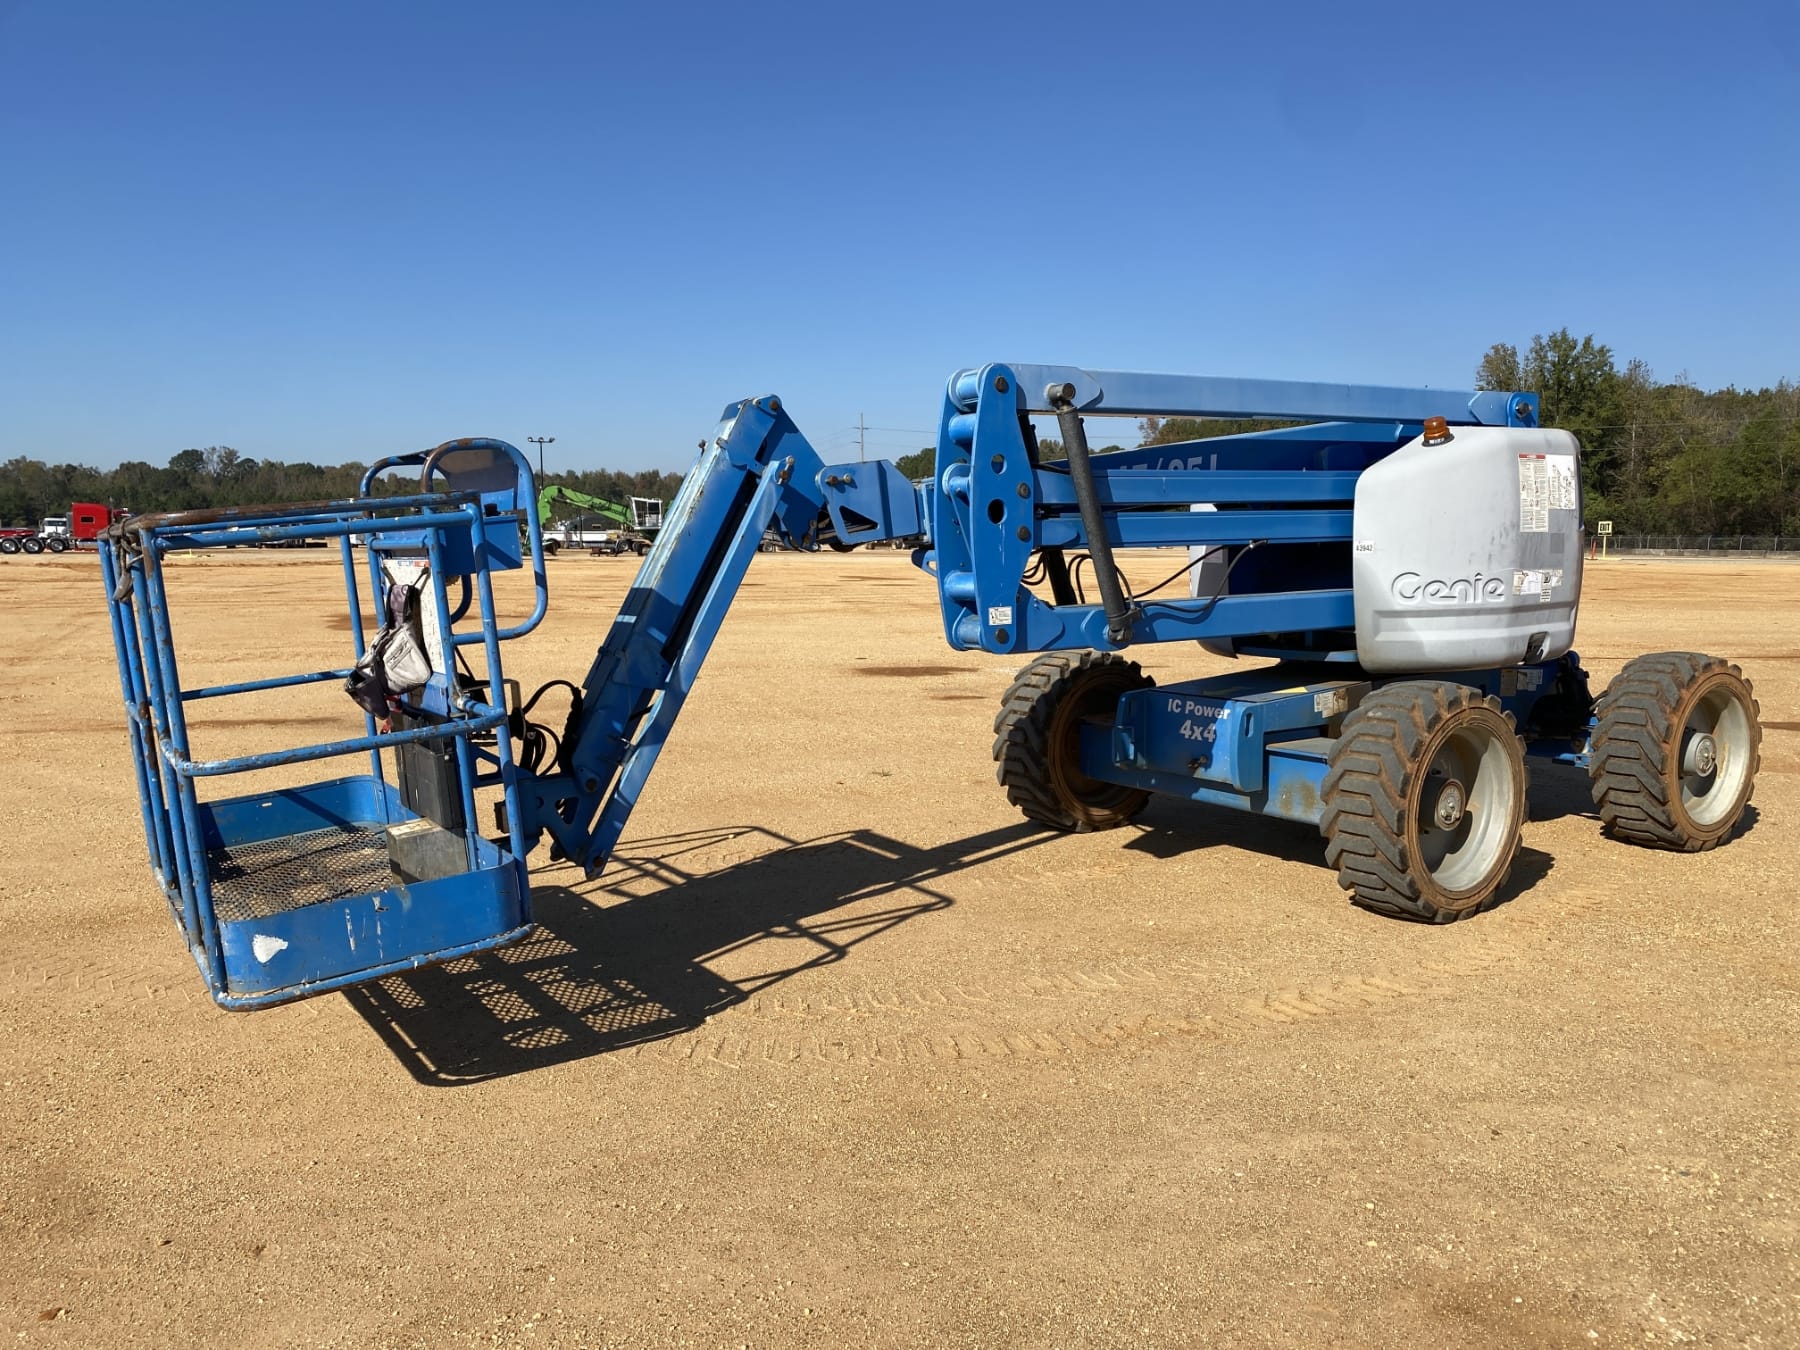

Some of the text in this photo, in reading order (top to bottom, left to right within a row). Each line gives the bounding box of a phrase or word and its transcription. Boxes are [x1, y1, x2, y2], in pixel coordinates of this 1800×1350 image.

[1391, 571, 1505, 605] Genie
[1167, 698, 1231, 720] IC Power
[1179, 719, 1216, 743] 4x4
